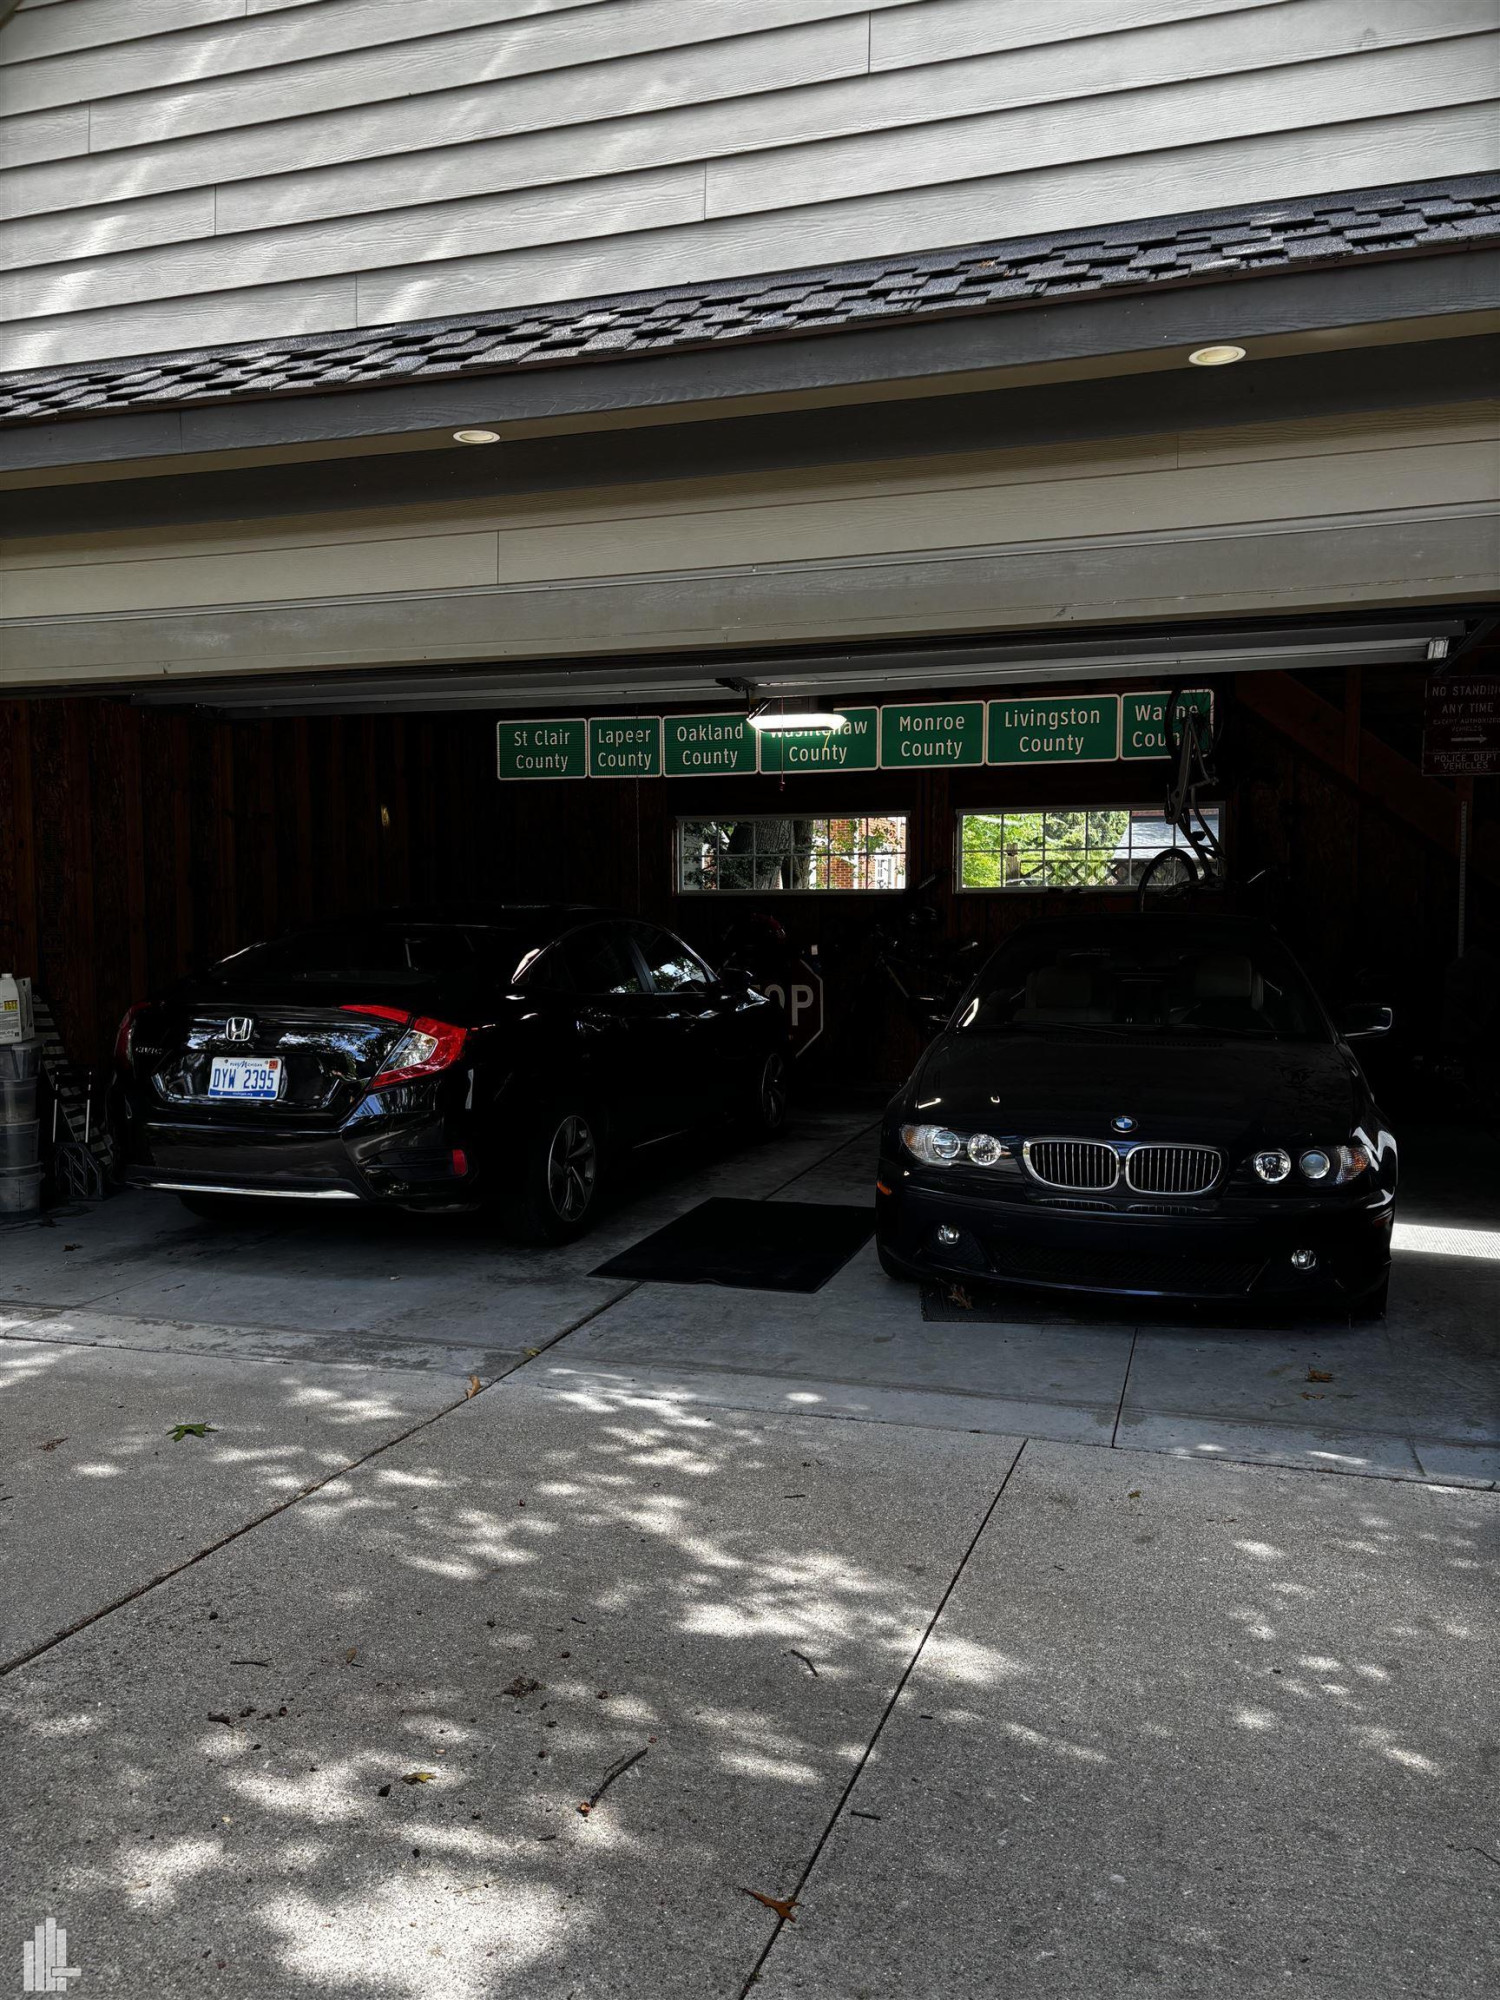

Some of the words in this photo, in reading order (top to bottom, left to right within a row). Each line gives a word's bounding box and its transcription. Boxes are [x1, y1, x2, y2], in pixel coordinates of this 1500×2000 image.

[1432, 686, 1447, 697] NO
[1453, 685, 1500, 696] STANDIN
[1135, 704, 1199, 721] Wane
[1442, 704, 1463, 714] ANY
[1470, 702, 1494, 714] TIME
[899, 715, 966, 732] Monroe
[1005, 708, 1101, 731] Livingston
[513, 731, 528, 747] St
[535, 729, 571, 746] Clair
[598, 728, 652, 747] Lapeer
[676, 722, 744, 743] Oakland
[1132, 730, 1184, 748] Coun
[900, 740, 963, 760] County
[1019, 734, 1085, 755] County
[515, 754, 569, 772] County
[598, 751, 652, 771] County
[682, 749, 739, 768] County
[788, 744, 848, 765] County
[1434, 754, 1466, 763] POLICE
[1473, 752, 1497, 762] DEPT
[1443, 761, 1488, 769] VEHICLES
[752, 984, 814, 1026] OP
[213, 1068, 237, 1089] DYW
[243, 1069, 275, 1090] 2395
